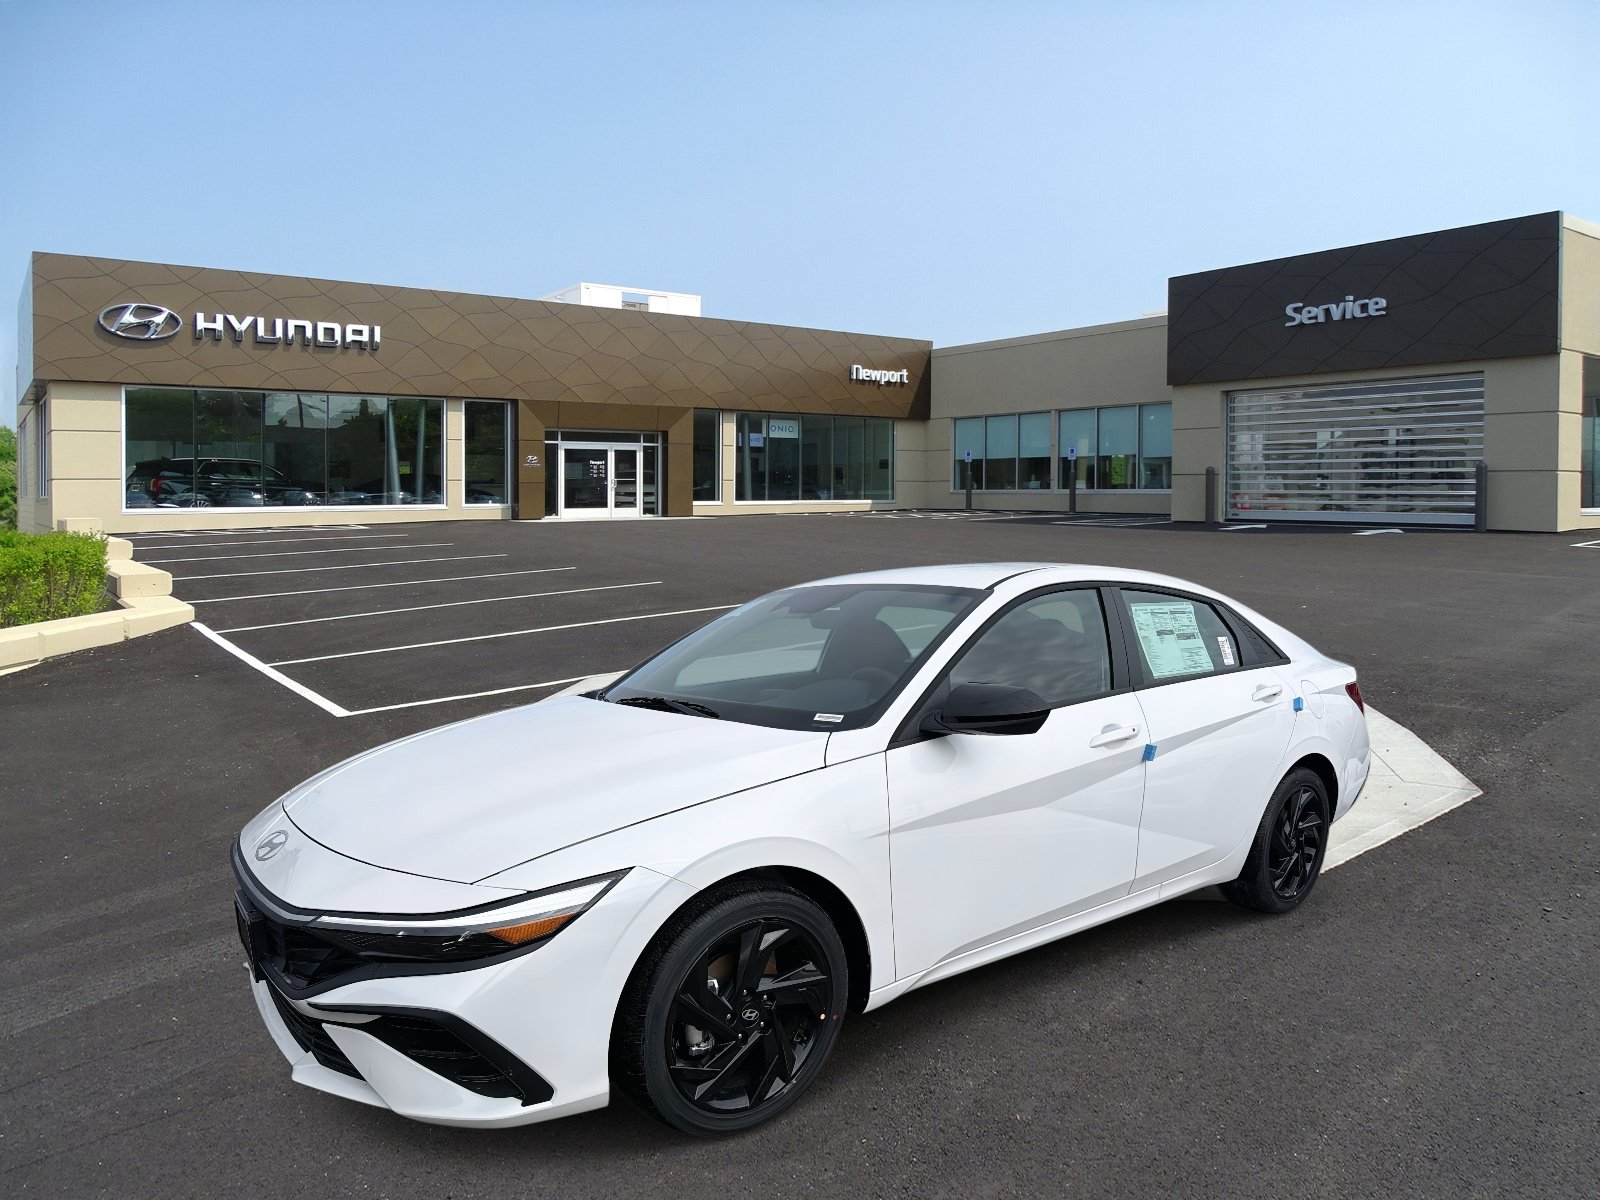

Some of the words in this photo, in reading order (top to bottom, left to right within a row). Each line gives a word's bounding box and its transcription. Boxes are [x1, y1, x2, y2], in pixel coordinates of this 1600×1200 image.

[1284, 295, 1387, 327] Service
[194, 312, 381, 350] HYUNDAI
[850, 364, 909, 385] Newport
